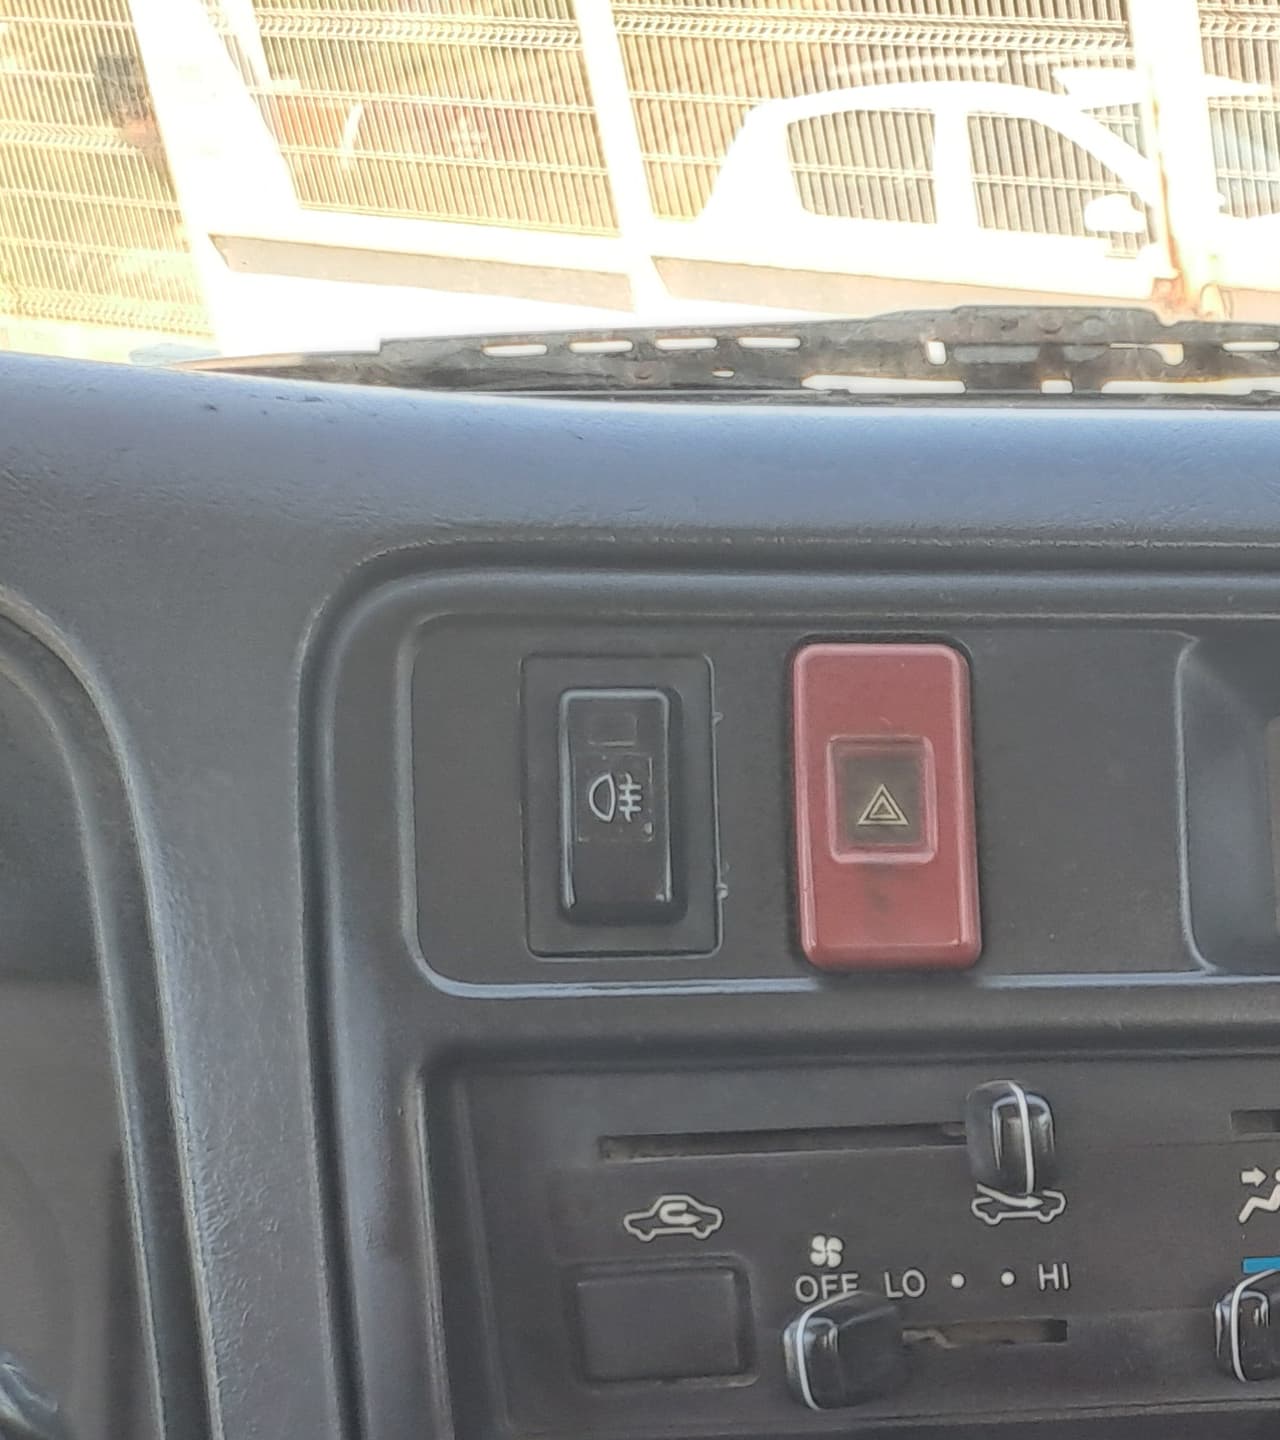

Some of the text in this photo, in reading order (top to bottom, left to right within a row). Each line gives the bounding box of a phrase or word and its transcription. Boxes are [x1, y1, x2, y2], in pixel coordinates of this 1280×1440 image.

[795, 1272, 860, 1303] OFF
[883, 1268, 927, 1299] LO
[1037, 1262, 1071, 1291] HI
